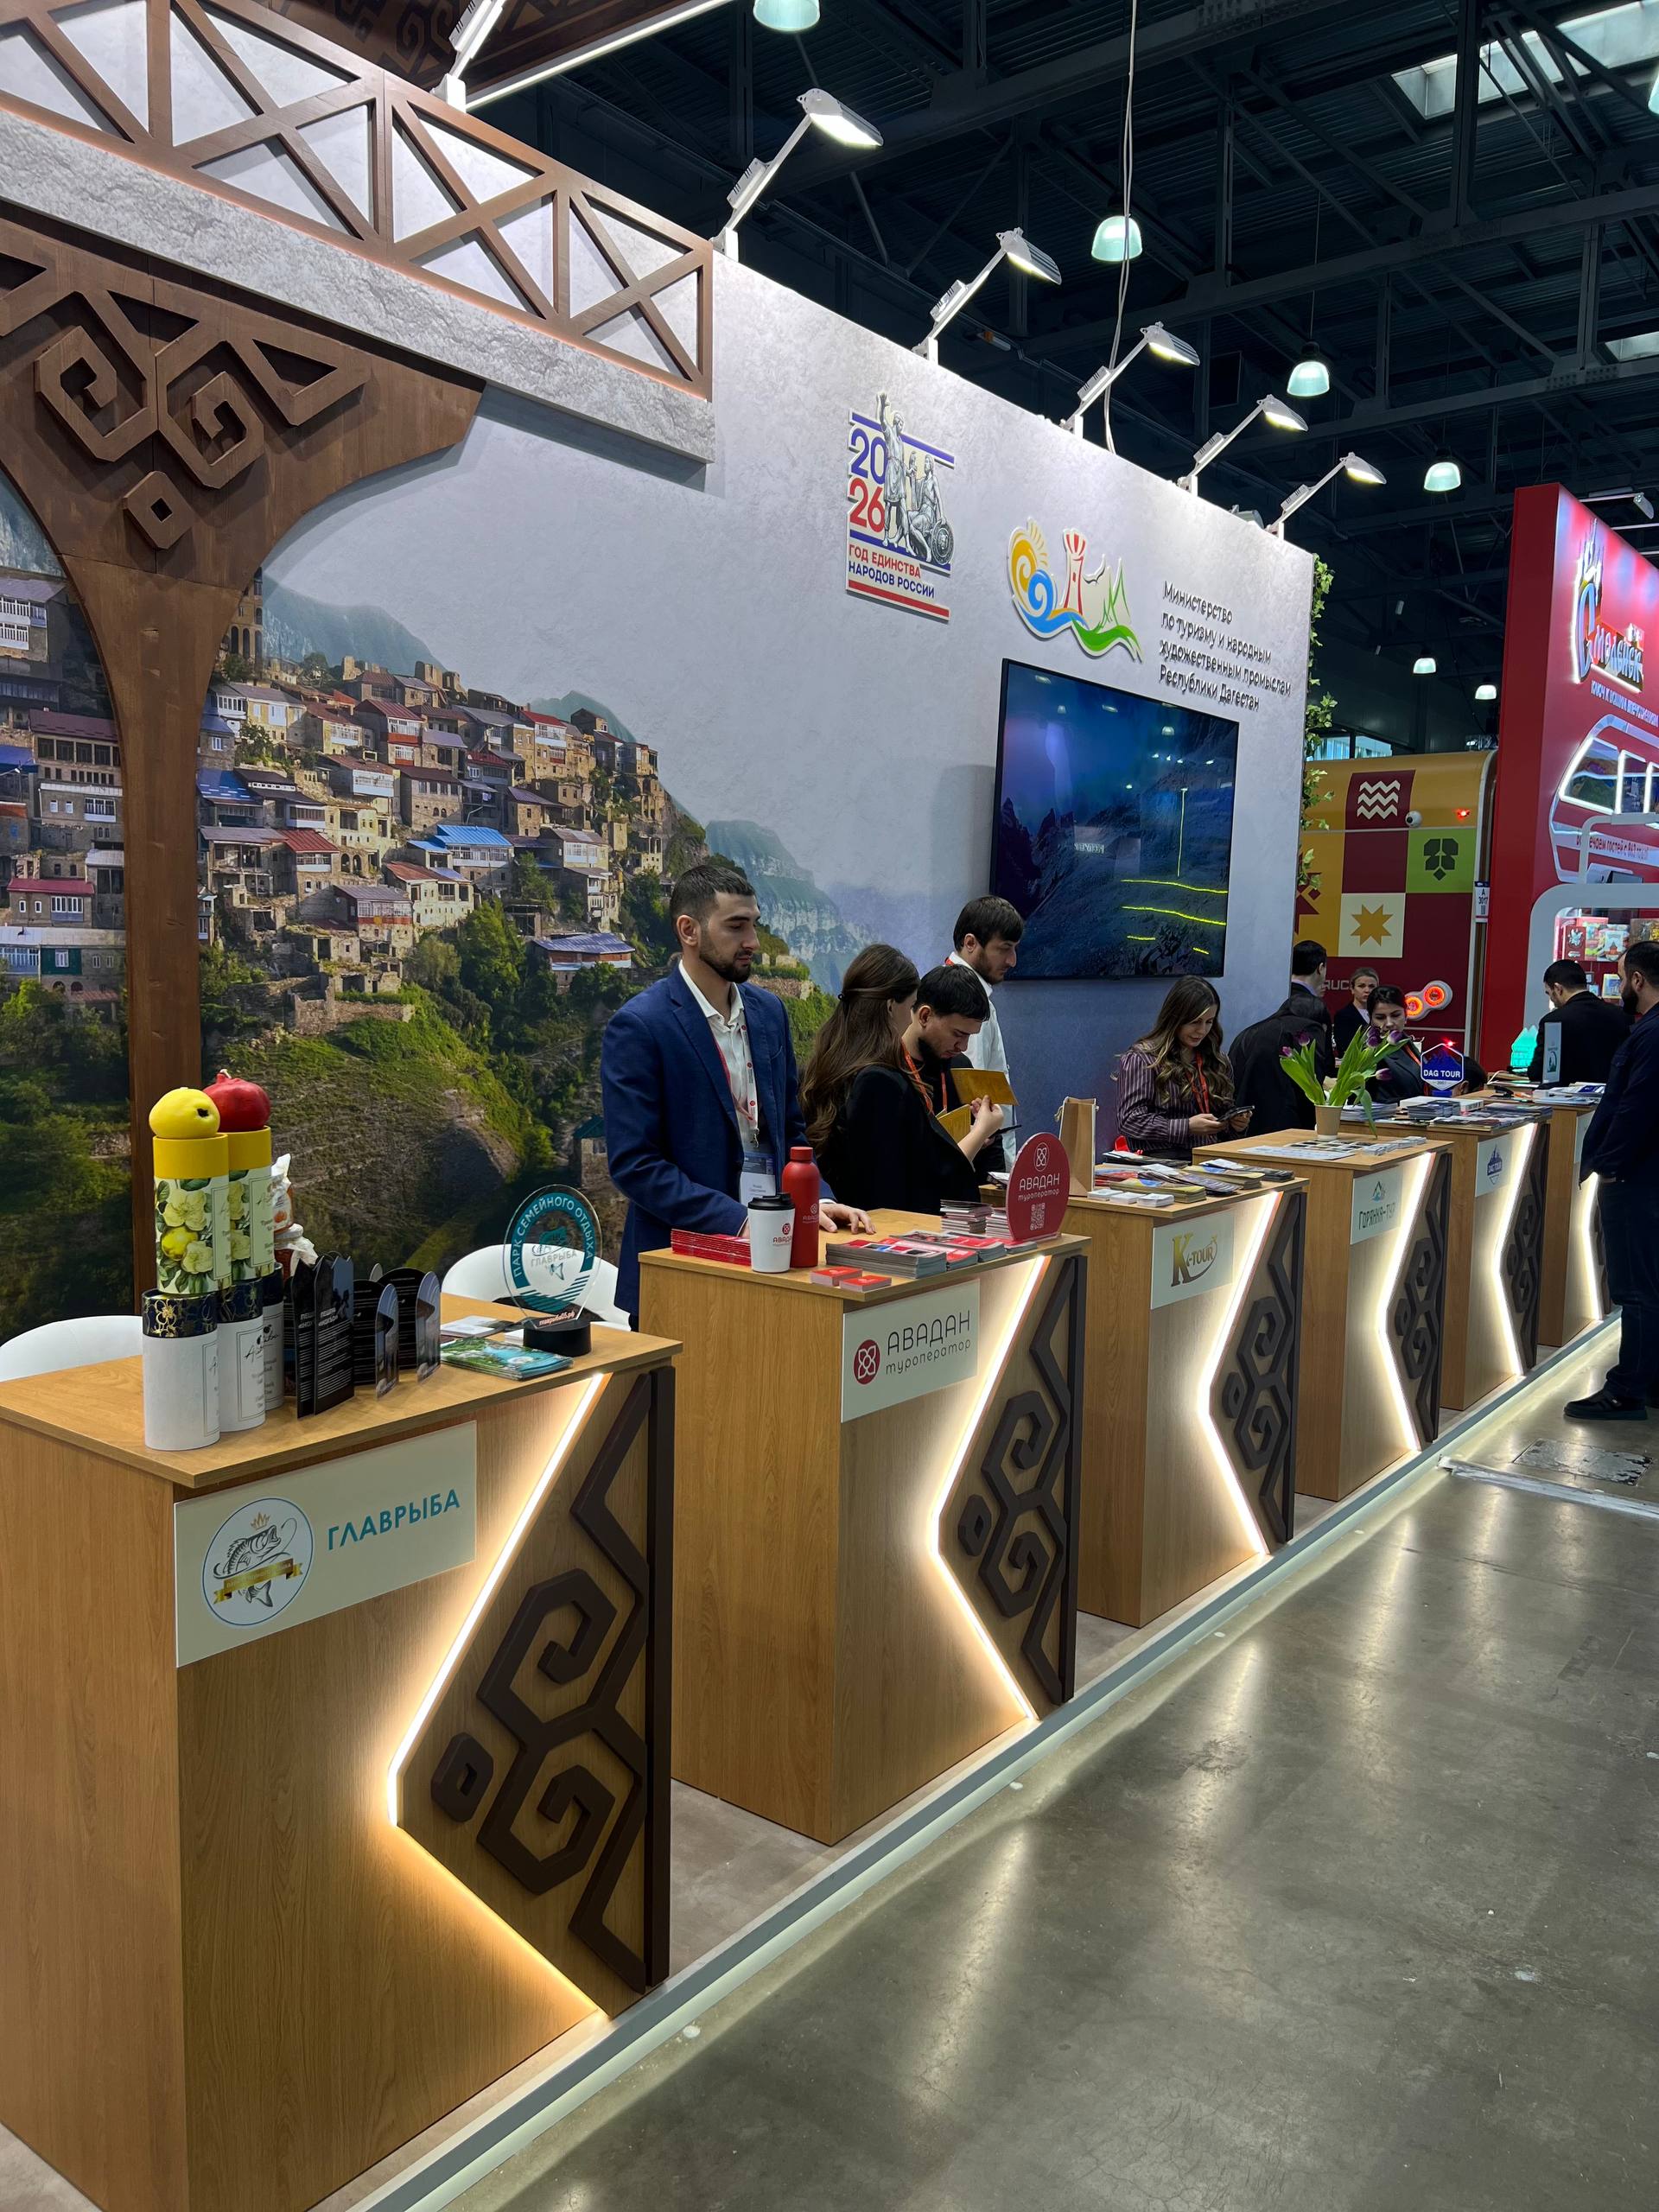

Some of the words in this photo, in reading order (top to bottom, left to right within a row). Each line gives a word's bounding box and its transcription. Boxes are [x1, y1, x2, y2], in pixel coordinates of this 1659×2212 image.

[850, 427, 887, 485] 20
[849, 477, 886, 533] 26
[849, 543, 869, 563] ГОД
[871, 552, 921, 579] ЕДИНСТВА
[849, 560, 895, 586] НАРОДОВ
[897, 576, 935, 599] РОССИИ
[1162, 580, 1234, 625] Министерство
[1161, 612, 1176, 631] по
[1176, 617, 1217, 649] туризму
[1217, 632, 1225, 649] и
[1225, 636, 1273, 665] народным
[1160, 639, 1243, 680] художественным
[1243, 666, 1292, 697] промыслам
[1160, 664, 1218, 700] Республики
[1218, 683, 1261, 712] Дагестан
[1018, 1188, 1060, 1202] туроператор
[1020, 1173, 1060, 1192] АВАДАН
[517, 1196, 575, 1236] СЕМЕЙНОГО
[575, 1207, 594, 1260] ОТДЫХА
[512, 1238, 523, 1278] ПАРК
[531, 1249, 578, 1268] ГЛАВРЫБА
[887, 1309, 970, 1357] АВАДАН
[886, 1338, 971, 1376] туроператор
[327, 1488, 461, 1551] ГЛАВРЫБА
